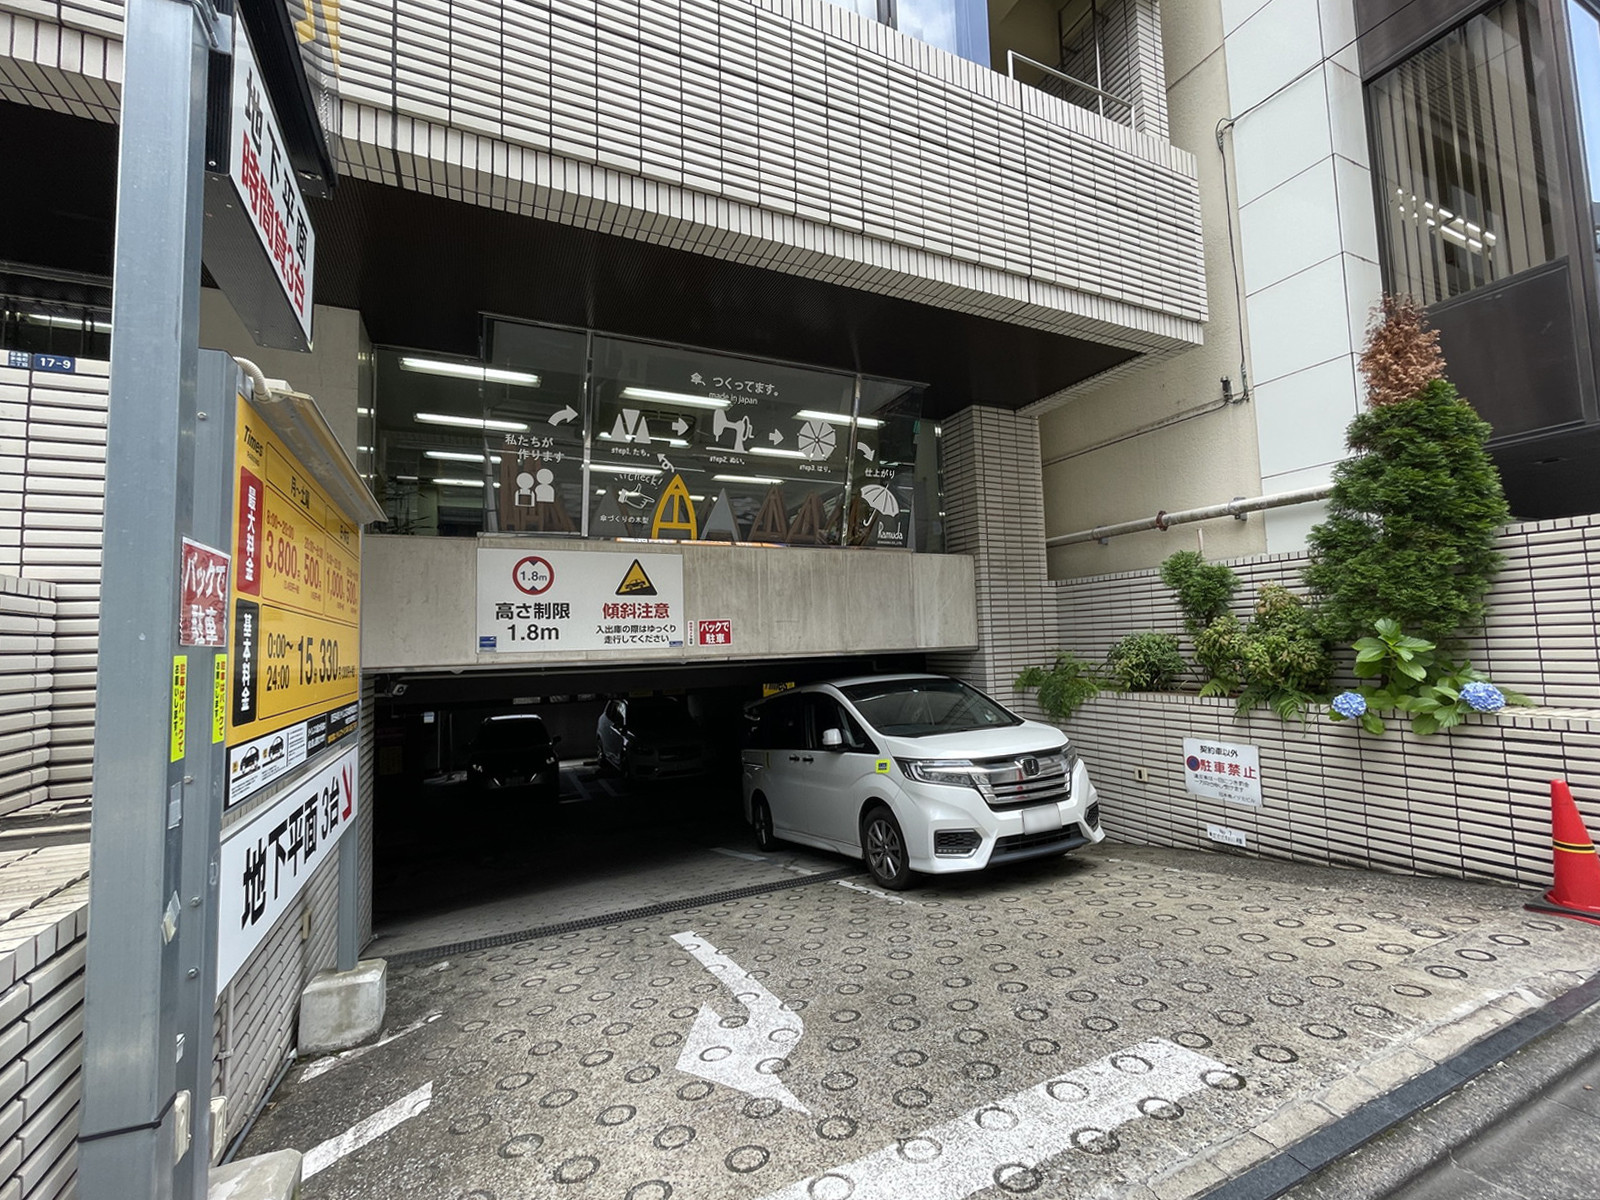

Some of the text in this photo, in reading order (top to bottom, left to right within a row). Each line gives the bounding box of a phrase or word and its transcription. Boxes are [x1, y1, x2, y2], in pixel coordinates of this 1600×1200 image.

[245, 67, 307, 269] 地下平面
[241, 130, 304, 317] 時間貸3台
[40, 357, 71, 369] 17-9
[244, 425, 263, 457] Times
[505, 433, 554, 448] 私たちが
[518, 449, 565, 463] 作ります
[865, 468, 895, 479] 仕上がり
[600, 514, 649, 524] 傘づくりの木型
[184, 551, 227, 601] バックで
[520, 571, 548, 582] 1.8m
[495, 602, 571, 620] 高さ制限
[602, 602, 670, 620] 傾斜注意
[191, 604, 219, 647] 駐車
[507, 624, 560, 641] 1.8m
[596, 624, 677, 635] 入出庫の際はゆっくり
[700, 621, 729, 632] バックで
[604, 635, 669, 645] 走行してください
[705, 633, 726, 644] 駐車
[241, 612, 253, 711] 基本料金
[266, 665, 290, 691] 24:00
[1200, 745, 1239, 758] 契約車以外
[1200, 759, 1258, 780] 駐車禁止
